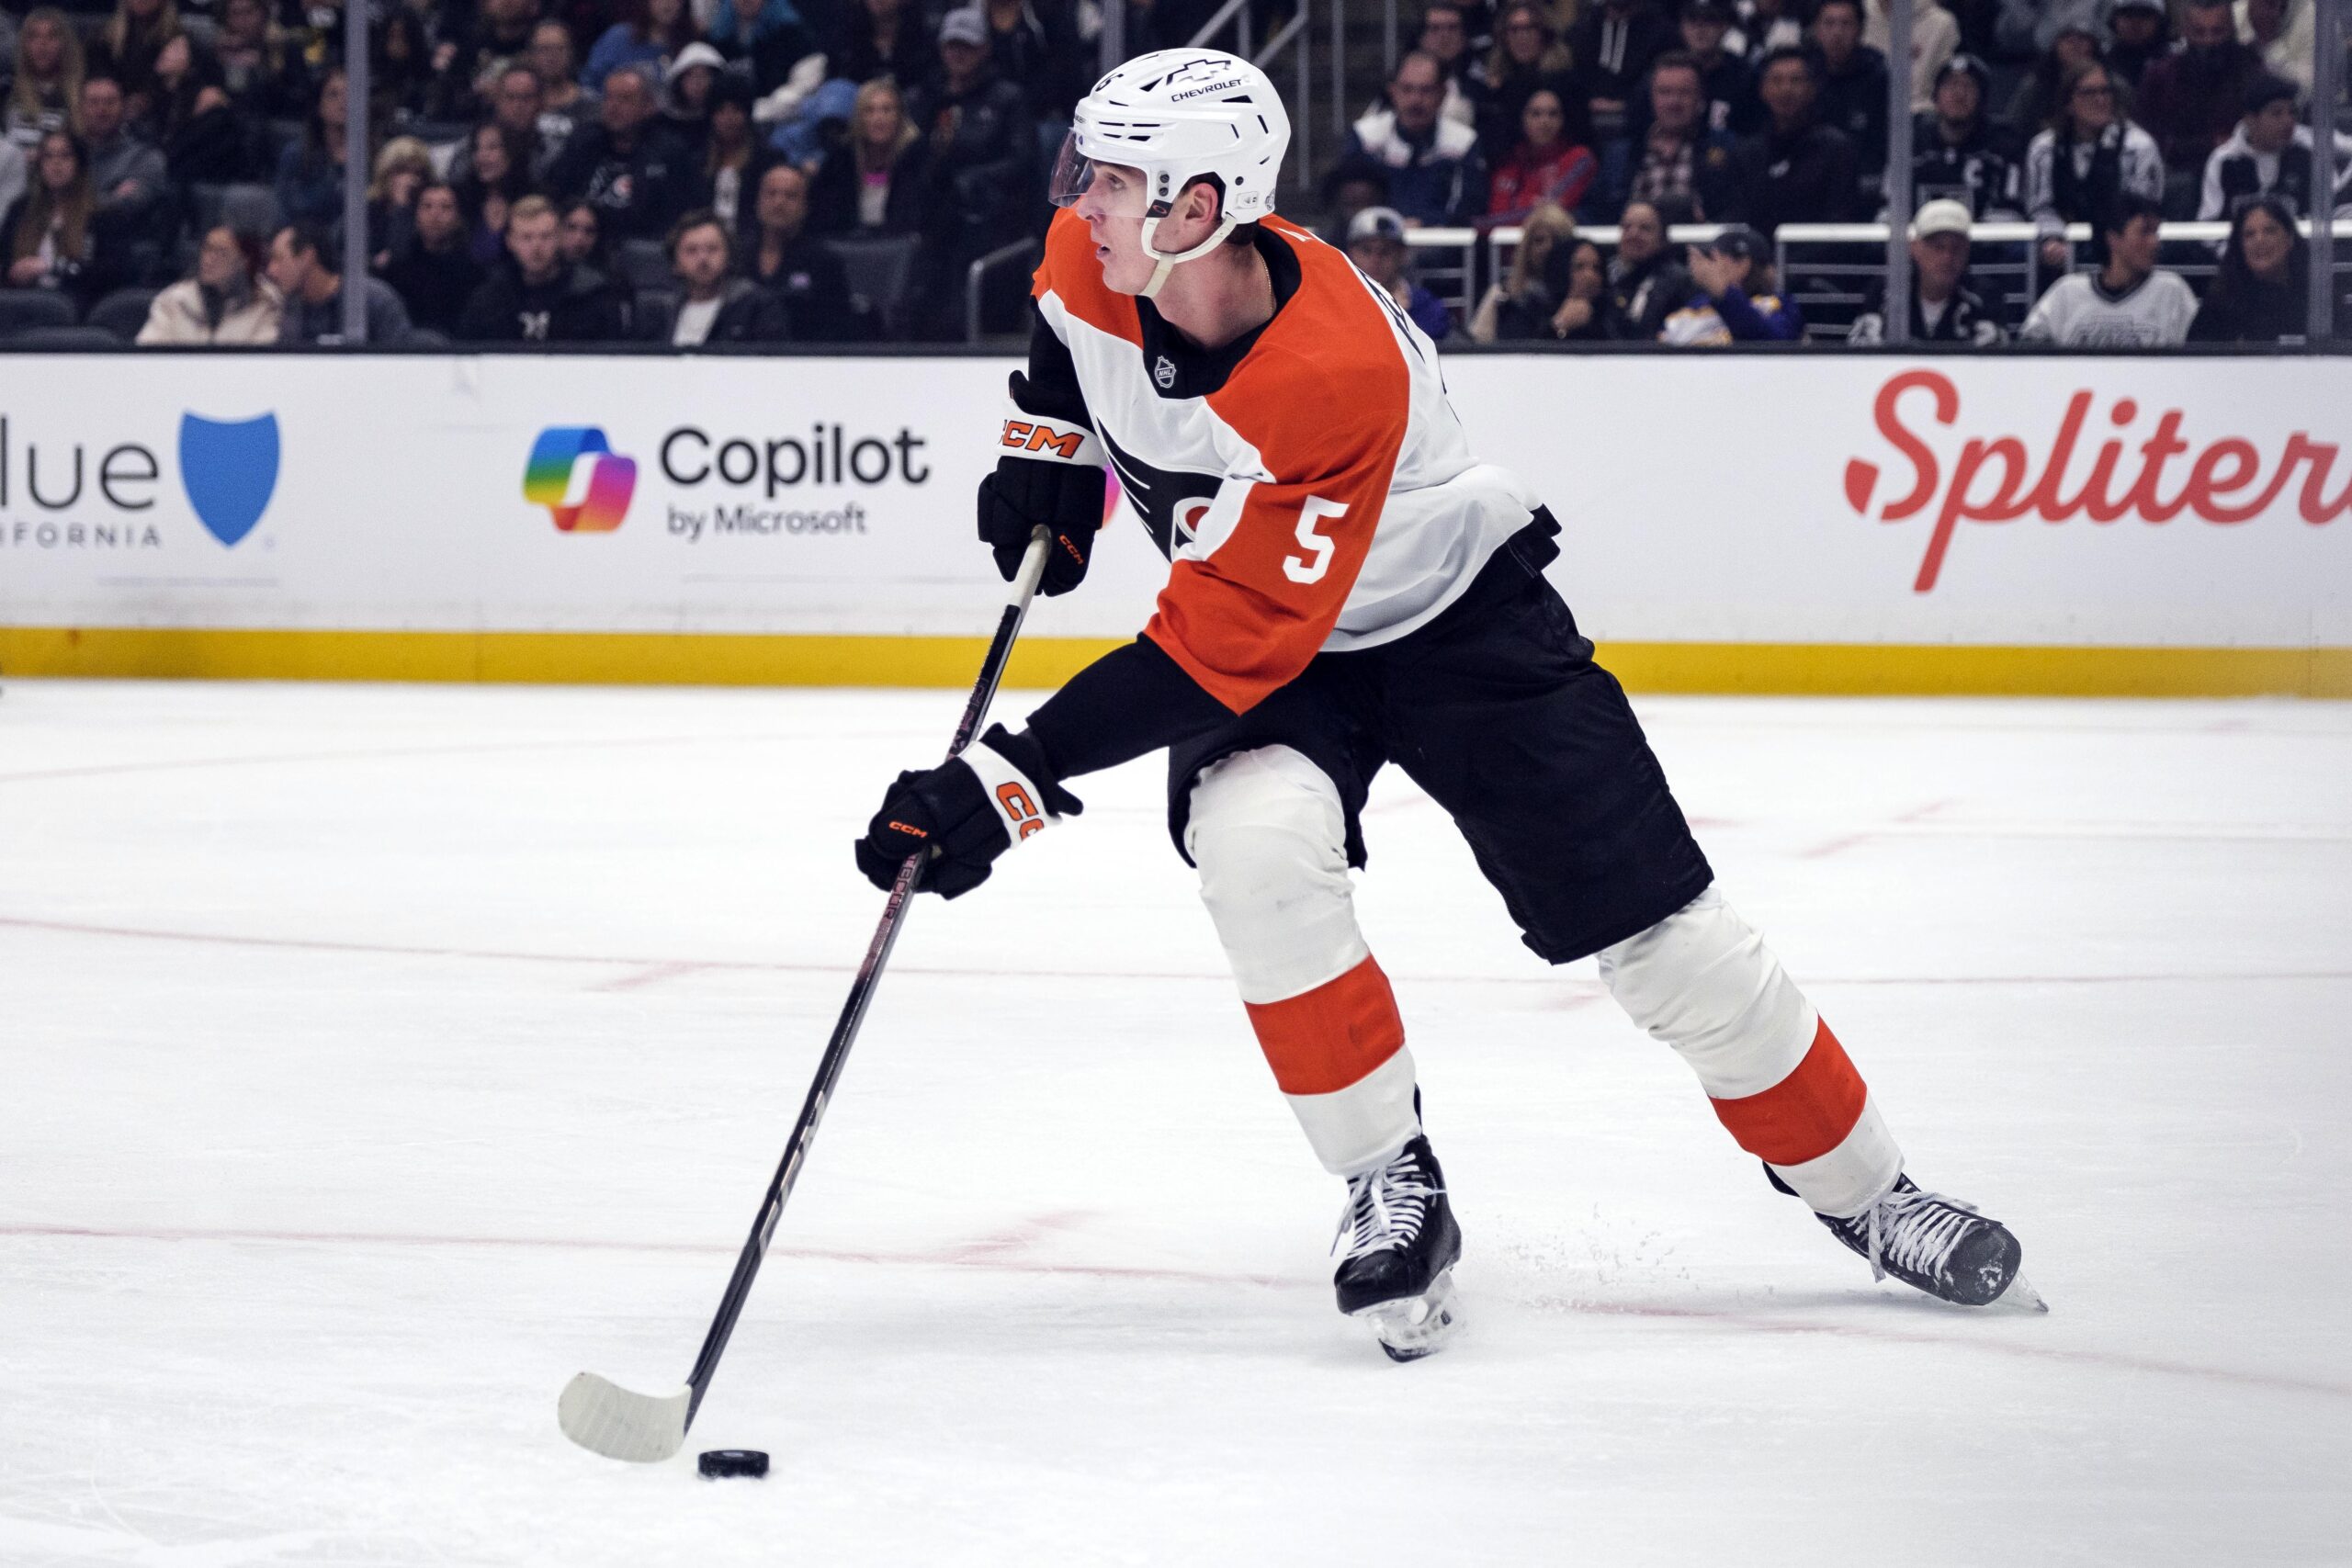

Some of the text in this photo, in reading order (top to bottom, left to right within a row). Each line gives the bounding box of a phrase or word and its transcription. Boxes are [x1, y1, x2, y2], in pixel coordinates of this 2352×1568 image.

[1170, 79, 1241, 102] CHEVROLET
[999, 420, 1084, 458] CM
[660, 423, 931, 499] Copilot
[1845, 368, 2352, 593] Spliter
[668, 504, 866, 542] by Microsoft
[1283, 494, 1350, 584] 5
[1059, 534, 1084, 565] CCM
[888, 820, 928, 839] CCM
